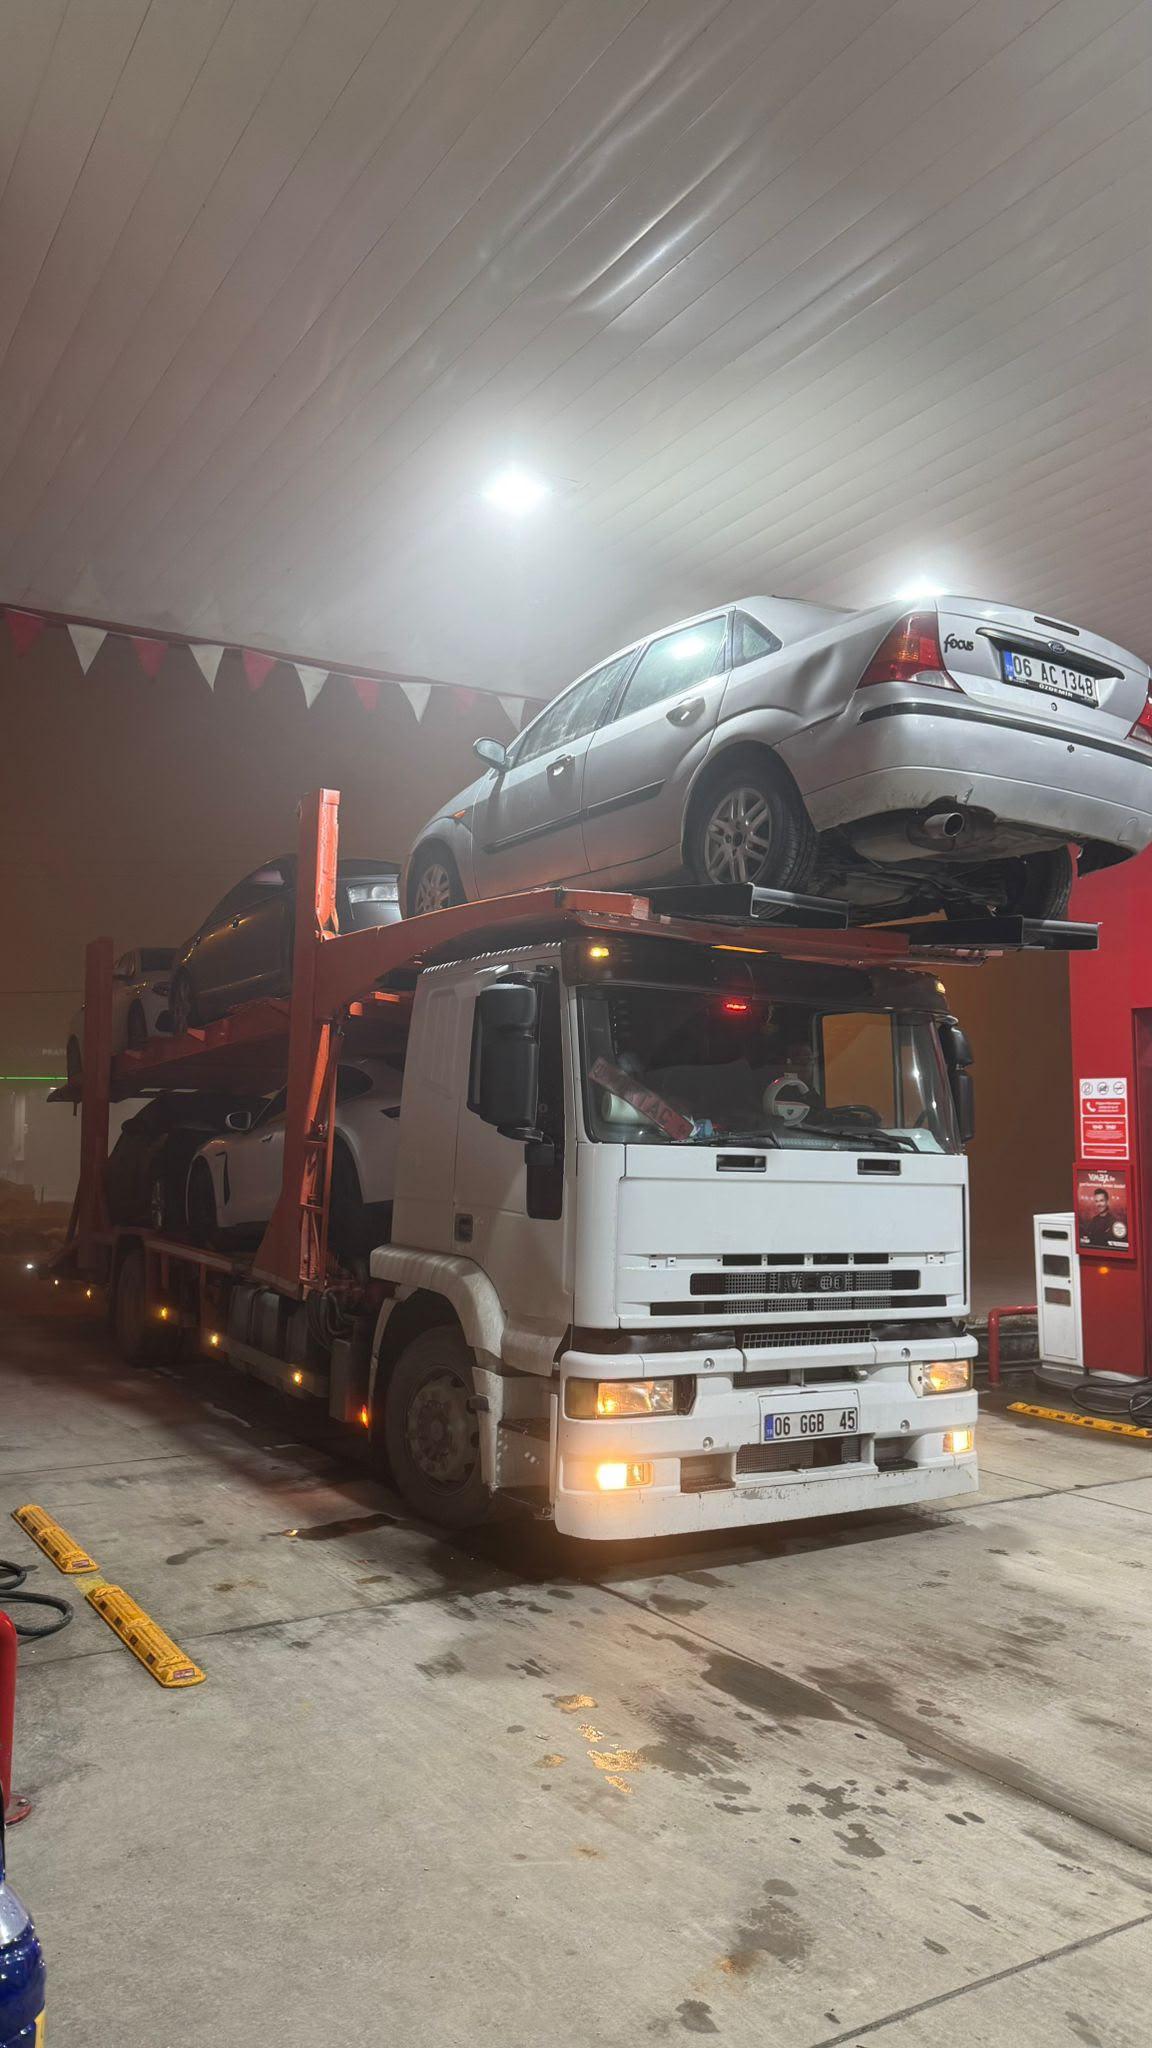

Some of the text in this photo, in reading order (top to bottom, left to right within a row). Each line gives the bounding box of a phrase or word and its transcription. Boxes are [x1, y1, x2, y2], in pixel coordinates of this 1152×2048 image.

[1013, 655, 1032, 677] 06
[1041, 662, 1058, 685] AC
[1062, 670, 1093, 697] 1348
[774, 1410, 855, 1436] 06 GGB 45
